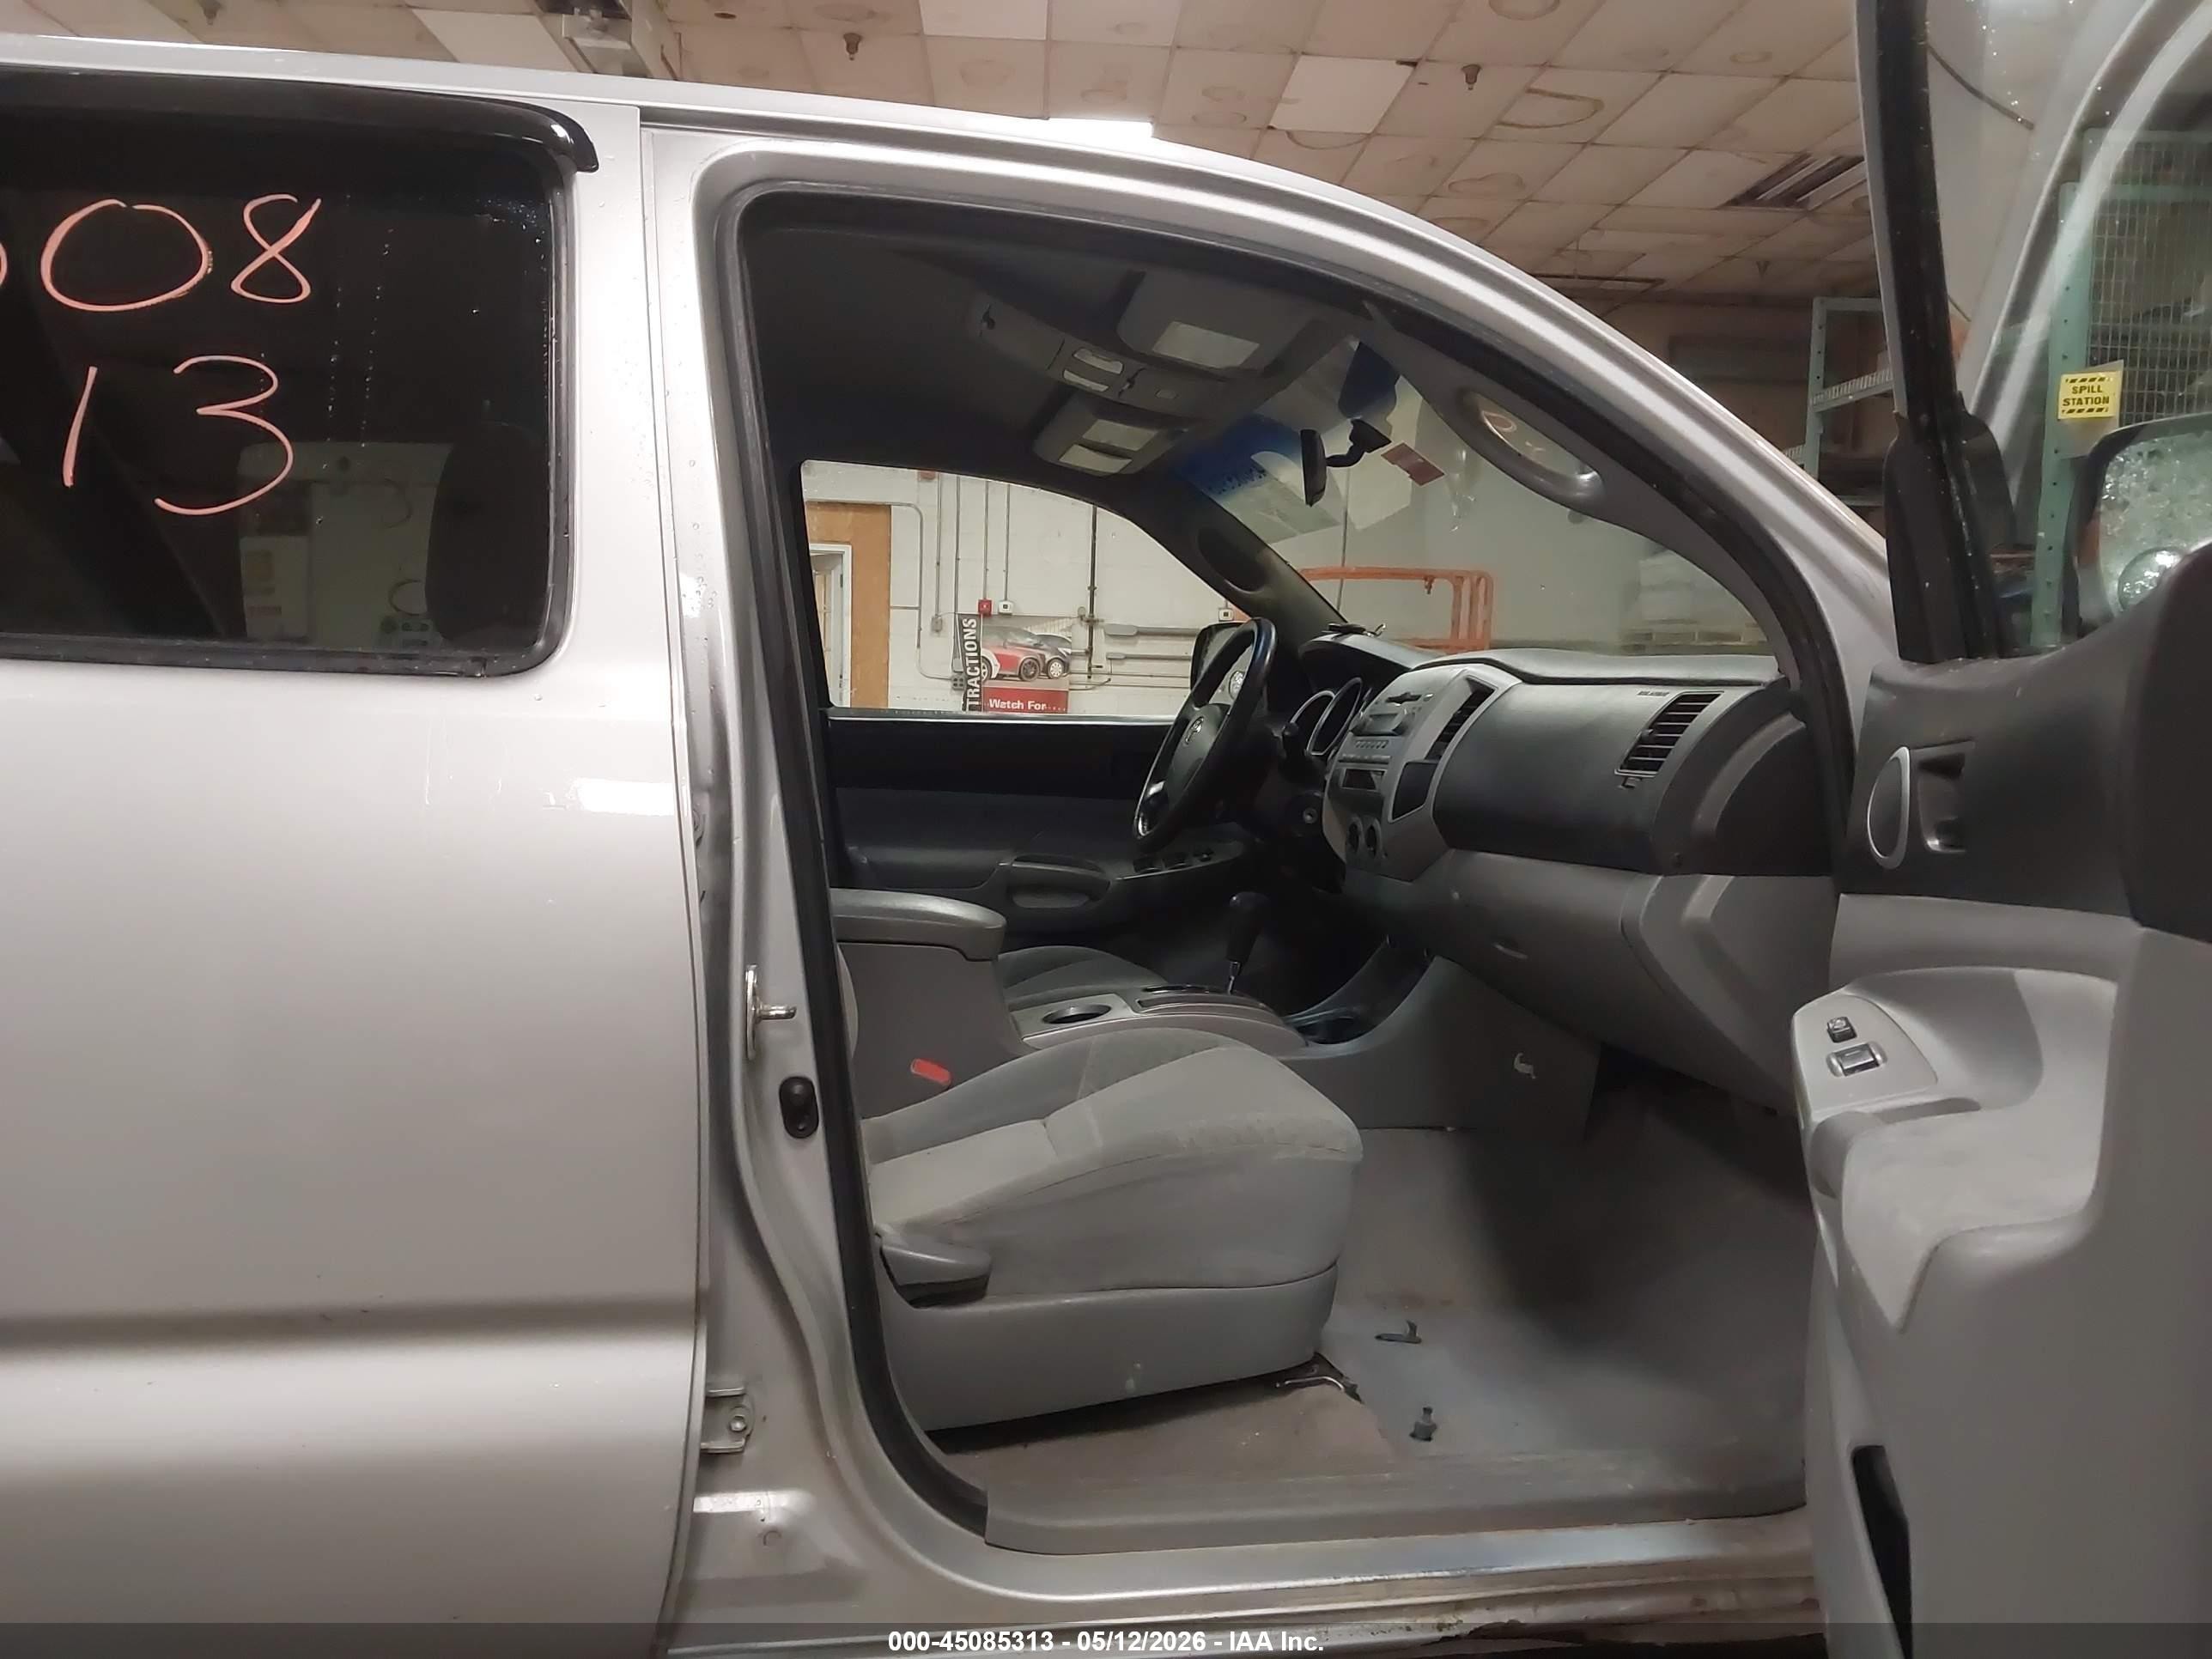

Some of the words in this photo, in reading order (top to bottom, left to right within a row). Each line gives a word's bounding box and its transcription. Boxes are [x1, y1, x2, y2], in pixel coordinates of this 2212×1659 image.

[0, 194, 323, 313] 08
[2071, 385, 2103, 395] SPILL
[2063, 396, 2110, 407] STATION
[62, 354, 295, 516] 13
[988, 698, 1024, 710] Watch
